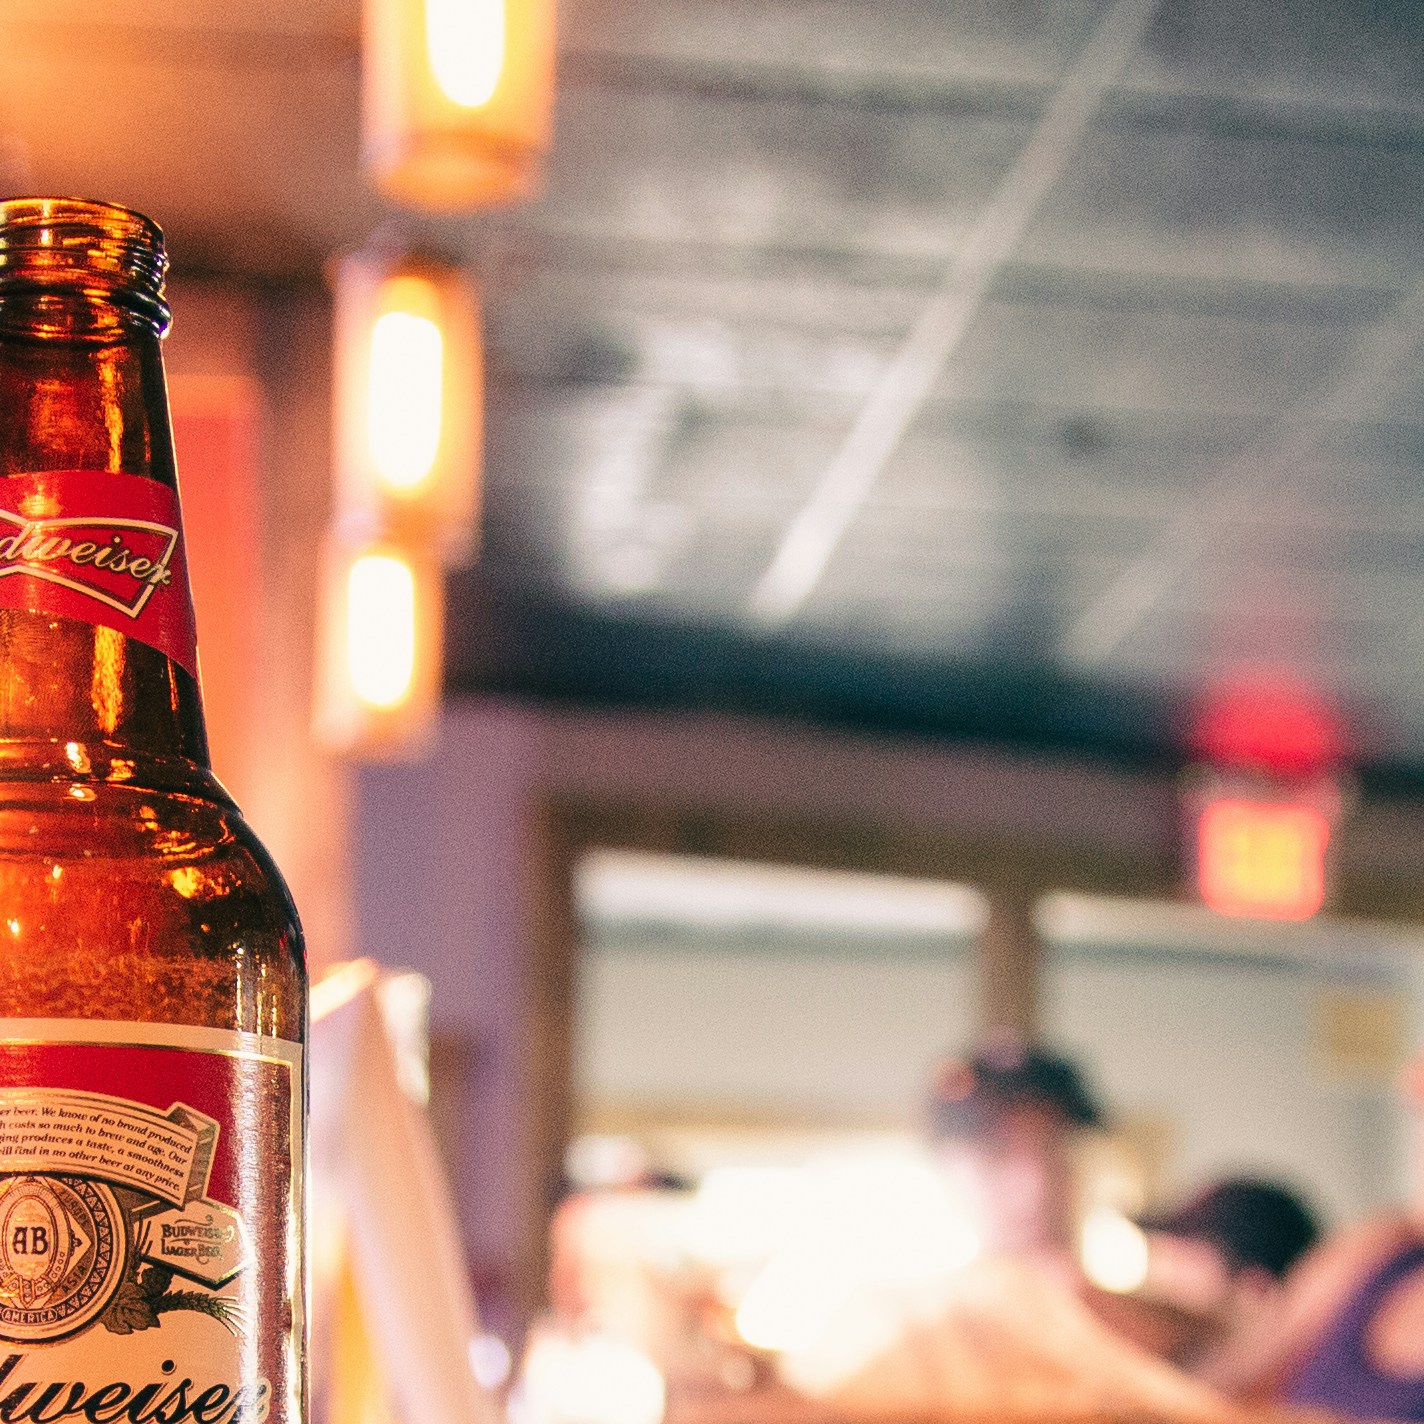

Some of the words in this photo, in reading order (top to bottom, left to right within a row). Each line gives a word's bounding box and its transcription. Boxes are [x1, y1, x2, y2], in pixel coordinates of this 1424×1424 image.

[9, 1118, 36, 1130] costs
[38, 1121, 51, 1130] so
[53, 1122, 84, 1135] much
[85, 1124, 96, 1136] to
[98, 1128, 125, 1142] brew
[126, 1136, 146, 1149] and
[147, 1143, 166, 1157] age.
[168, 1150, 188, 1166] Our
[41, 1106, 56, 1118] We
[58, 1107, 89, 1121] know
[89, 1112, 102, 1124] of
[102, 1115, 116, 1126] no
[117, 1119, 148, 1136] brand
[148, 1130, 193, 1155] produced
[14, 1145, 37, 1156] find
[40, 1145, 50, 1156] in
[52, 1148, 66, 1158] no
[68, 1149, 98, 1163] other
[98, 1154, 123, 1169] beer
[123, 1162, 135, 1174] at
[135, 1166, 155, 1182] any
[154, 1172, 181, 1192] price.
[21, 1131, 73, 1146] produces
[75, 1138, 83, 1147] a
[117, 1146, 124, 1156] a
[126, 1149, 185, 1178] smoothness
[12, 1225, 49, 1256] AB
[62, 1264, 86, 1293] ASIA
[3, 1308, 55, 1323] AMERICA
